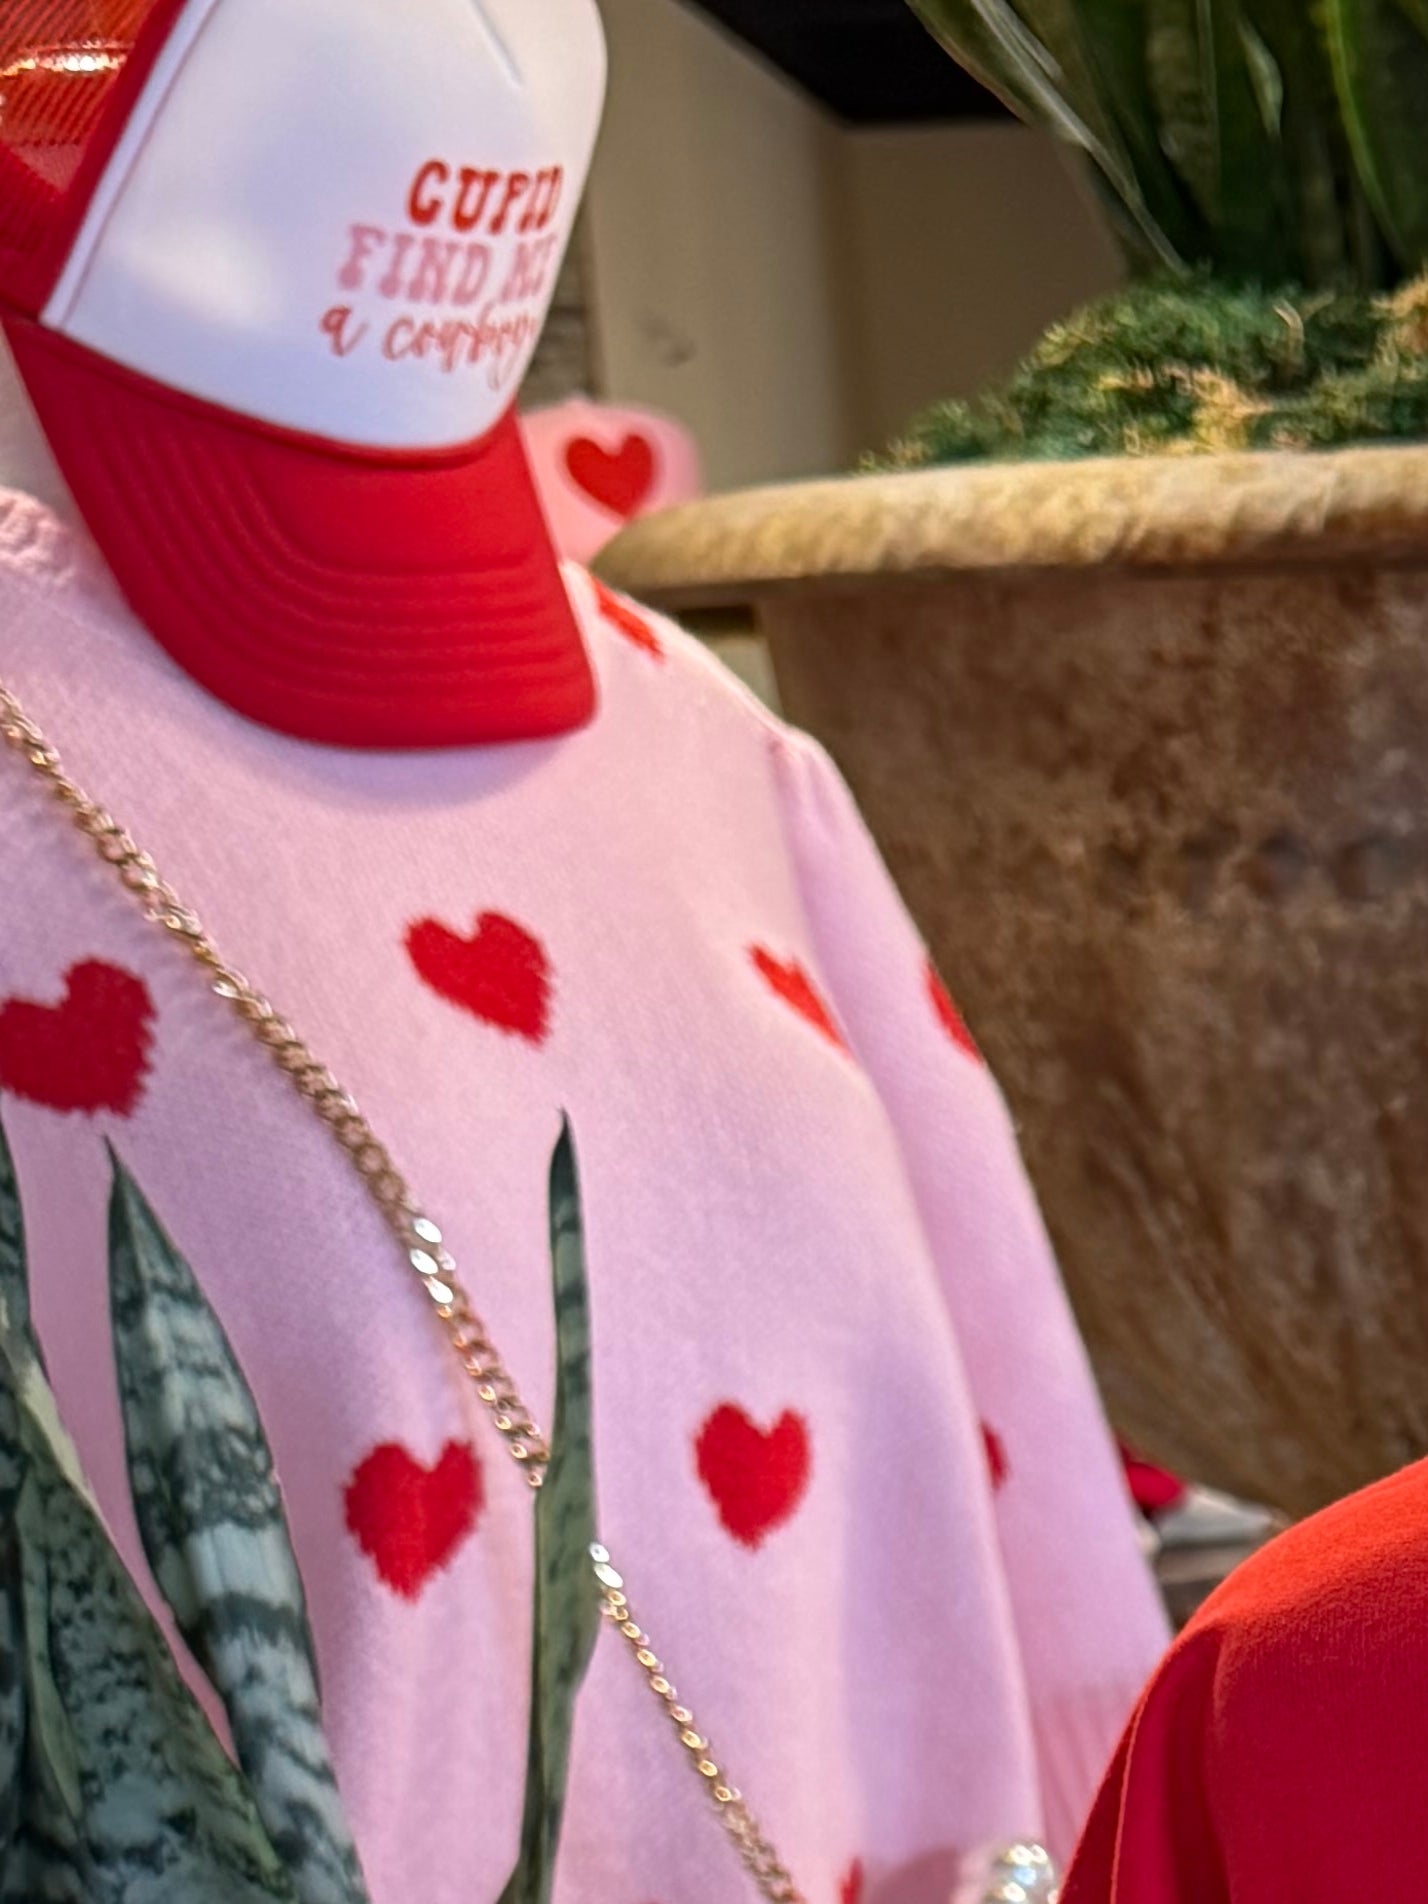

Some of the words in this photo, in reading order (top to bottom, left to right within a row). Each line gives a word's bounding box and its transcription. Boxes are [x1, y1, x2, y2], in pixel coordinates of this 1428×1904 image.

[406, 158, 563, 235] CUPID
[337, 222, 491, 306] FIND
[320, 304, 370, 357] a
